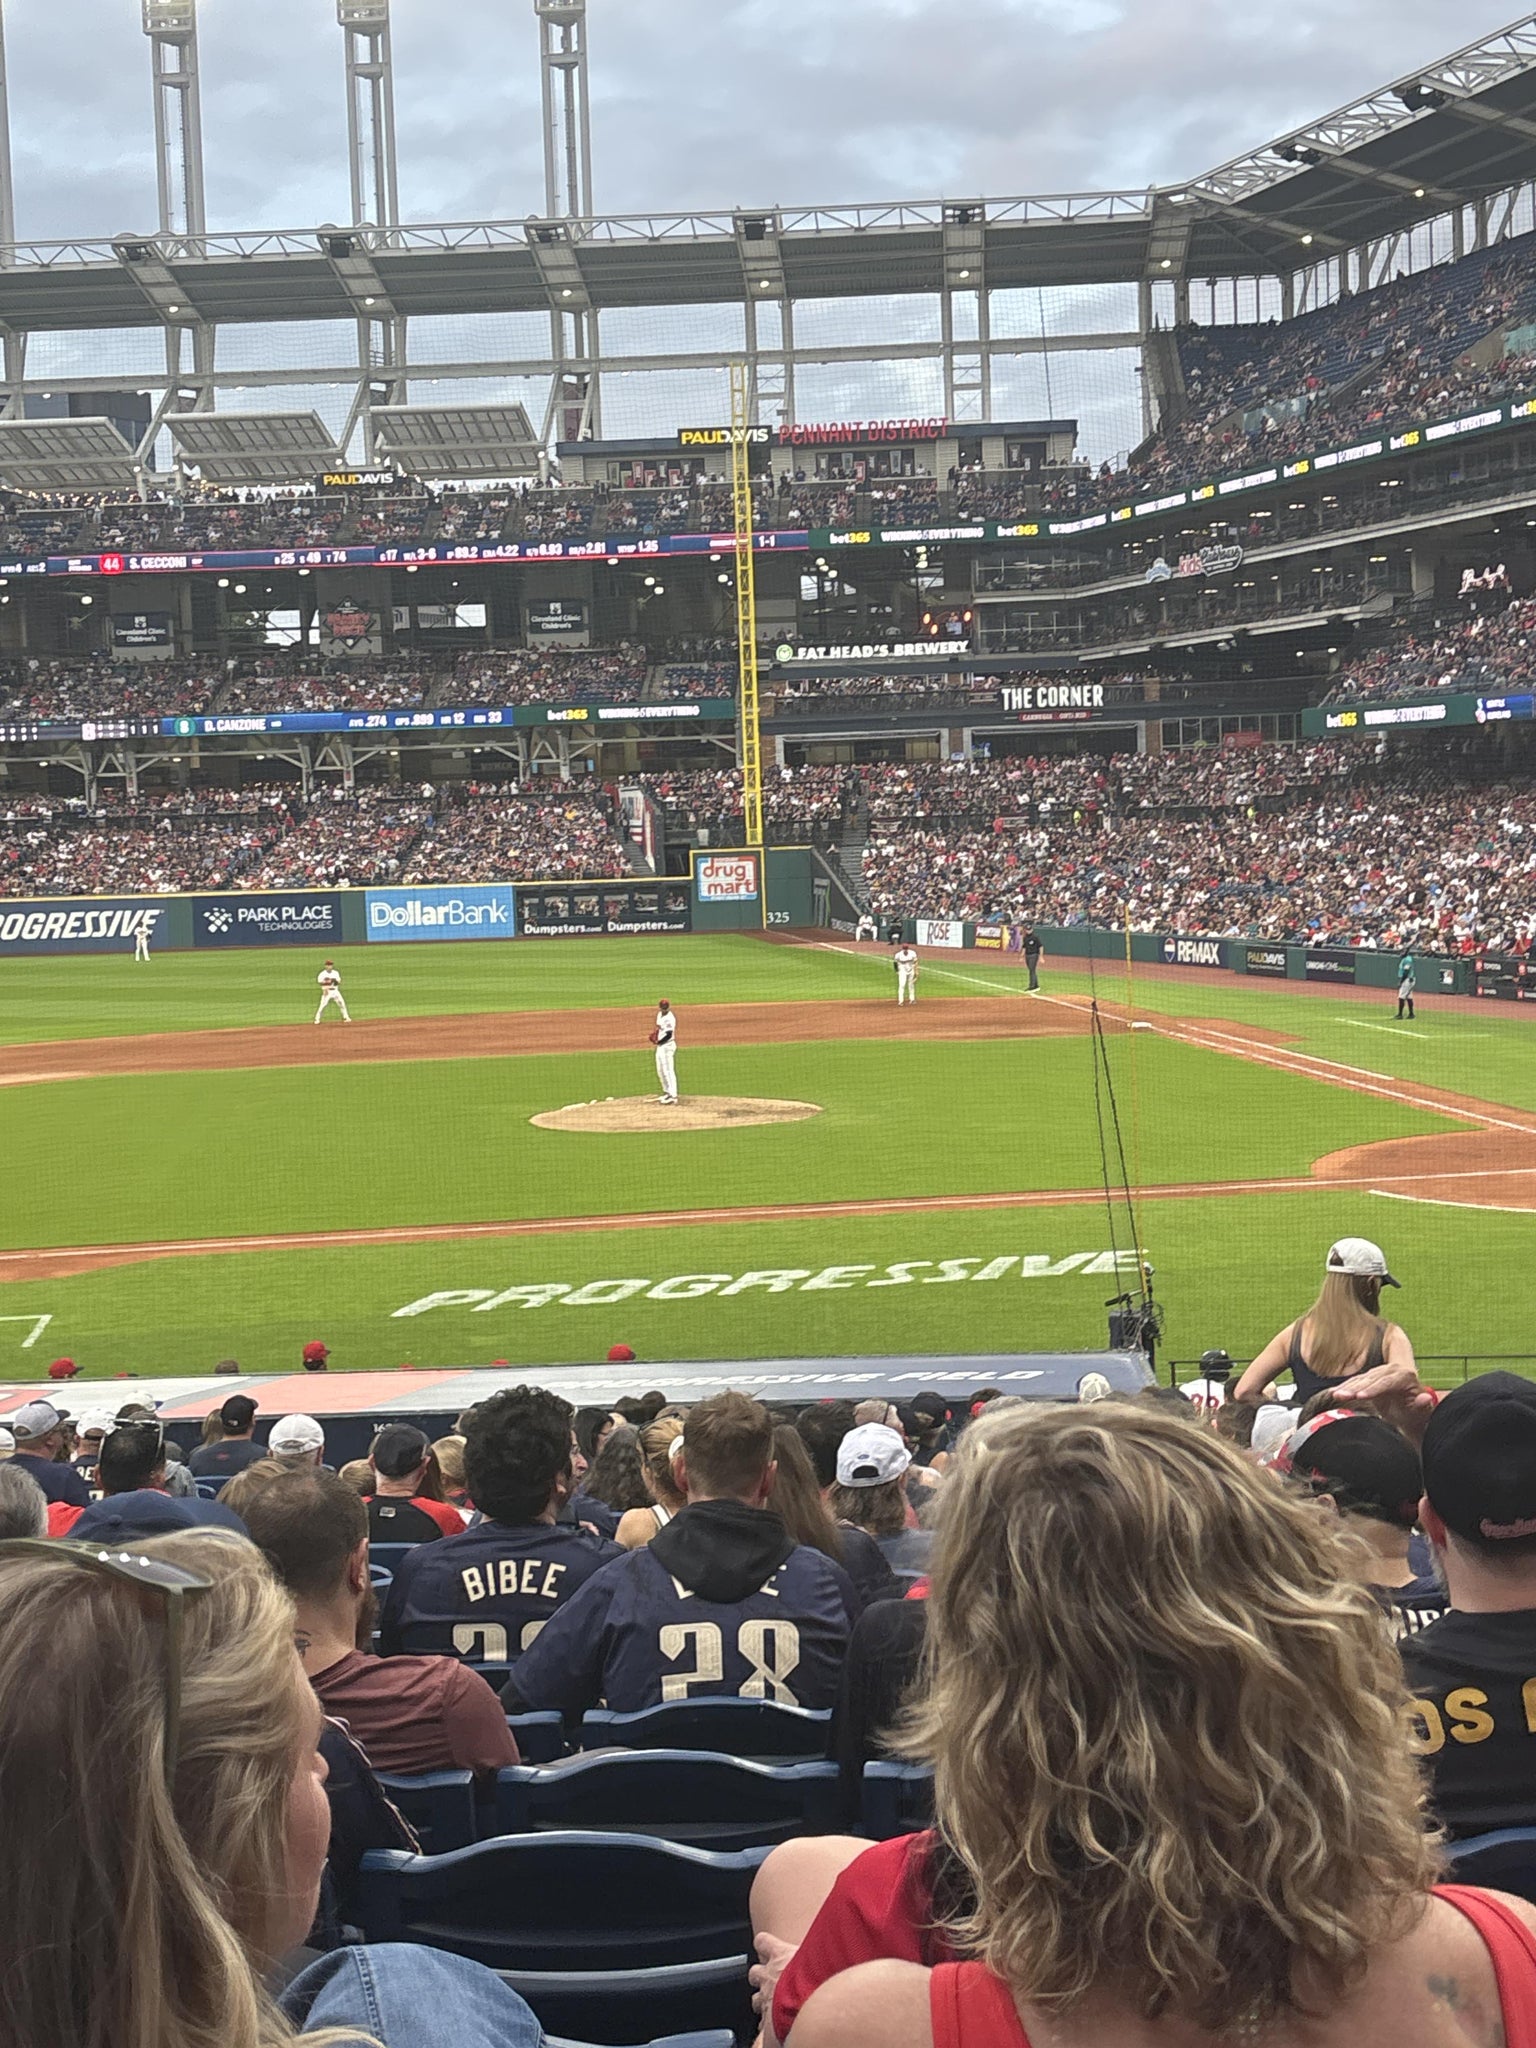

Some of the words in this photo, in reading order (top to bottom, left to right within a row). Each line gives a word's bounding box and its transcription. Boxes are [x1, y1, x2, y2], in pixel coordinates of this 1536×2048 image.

[779, 421, 863, 445] PENNANT
[868, 417, 948, 441] DISTRICT
[997, 524, 1038, 537] bet365
[759, 535, 775, 547] 1-1
[830, 532, 870, 544] bet365
[281, 553, 295, 564] 25
[307, 552, 321, 563] 49
[332, 551, 347, 562] 74
[104, 558, 119, 570] 44
[130, 558, 139, 570] S.
[142, 557, 186, 569] CECCONI
[798, 648, 826, 660] FAT
[830, 645, 889, 658] HEAD'S
[893, 641, 969, 656] BREWERY
[1001, 688, 1032, 711] THE
[1037, 684, 1104, 708] CORNER
[453, 712, 465, 724] 12
[547, 709, 588, 721] bet365
[217, 718, 266, 731] CANZONE
[703, 857, 746, 881] drug
[708, 879, 757, 895] mart
[238, 908, 276, 921] PARK
[282, 905, 332, 919] PLACE
[371, 898, 507, 927] DollarBank
[767, 912, 789, 923] 325
[258, 920, 333, 931] TECHNOLOGIES
[926, 922, 951, 944] ROSE
[390, 1248, 1147, 1318] PROGRESSIVE
[543, 1372, 884, 1390] PROGRESSIVE
[888, 1370, 1045, 1383] FIELD
[461, 1559, 567, 1602] BIBEE
[659, 1619, 800, 1707] 28
